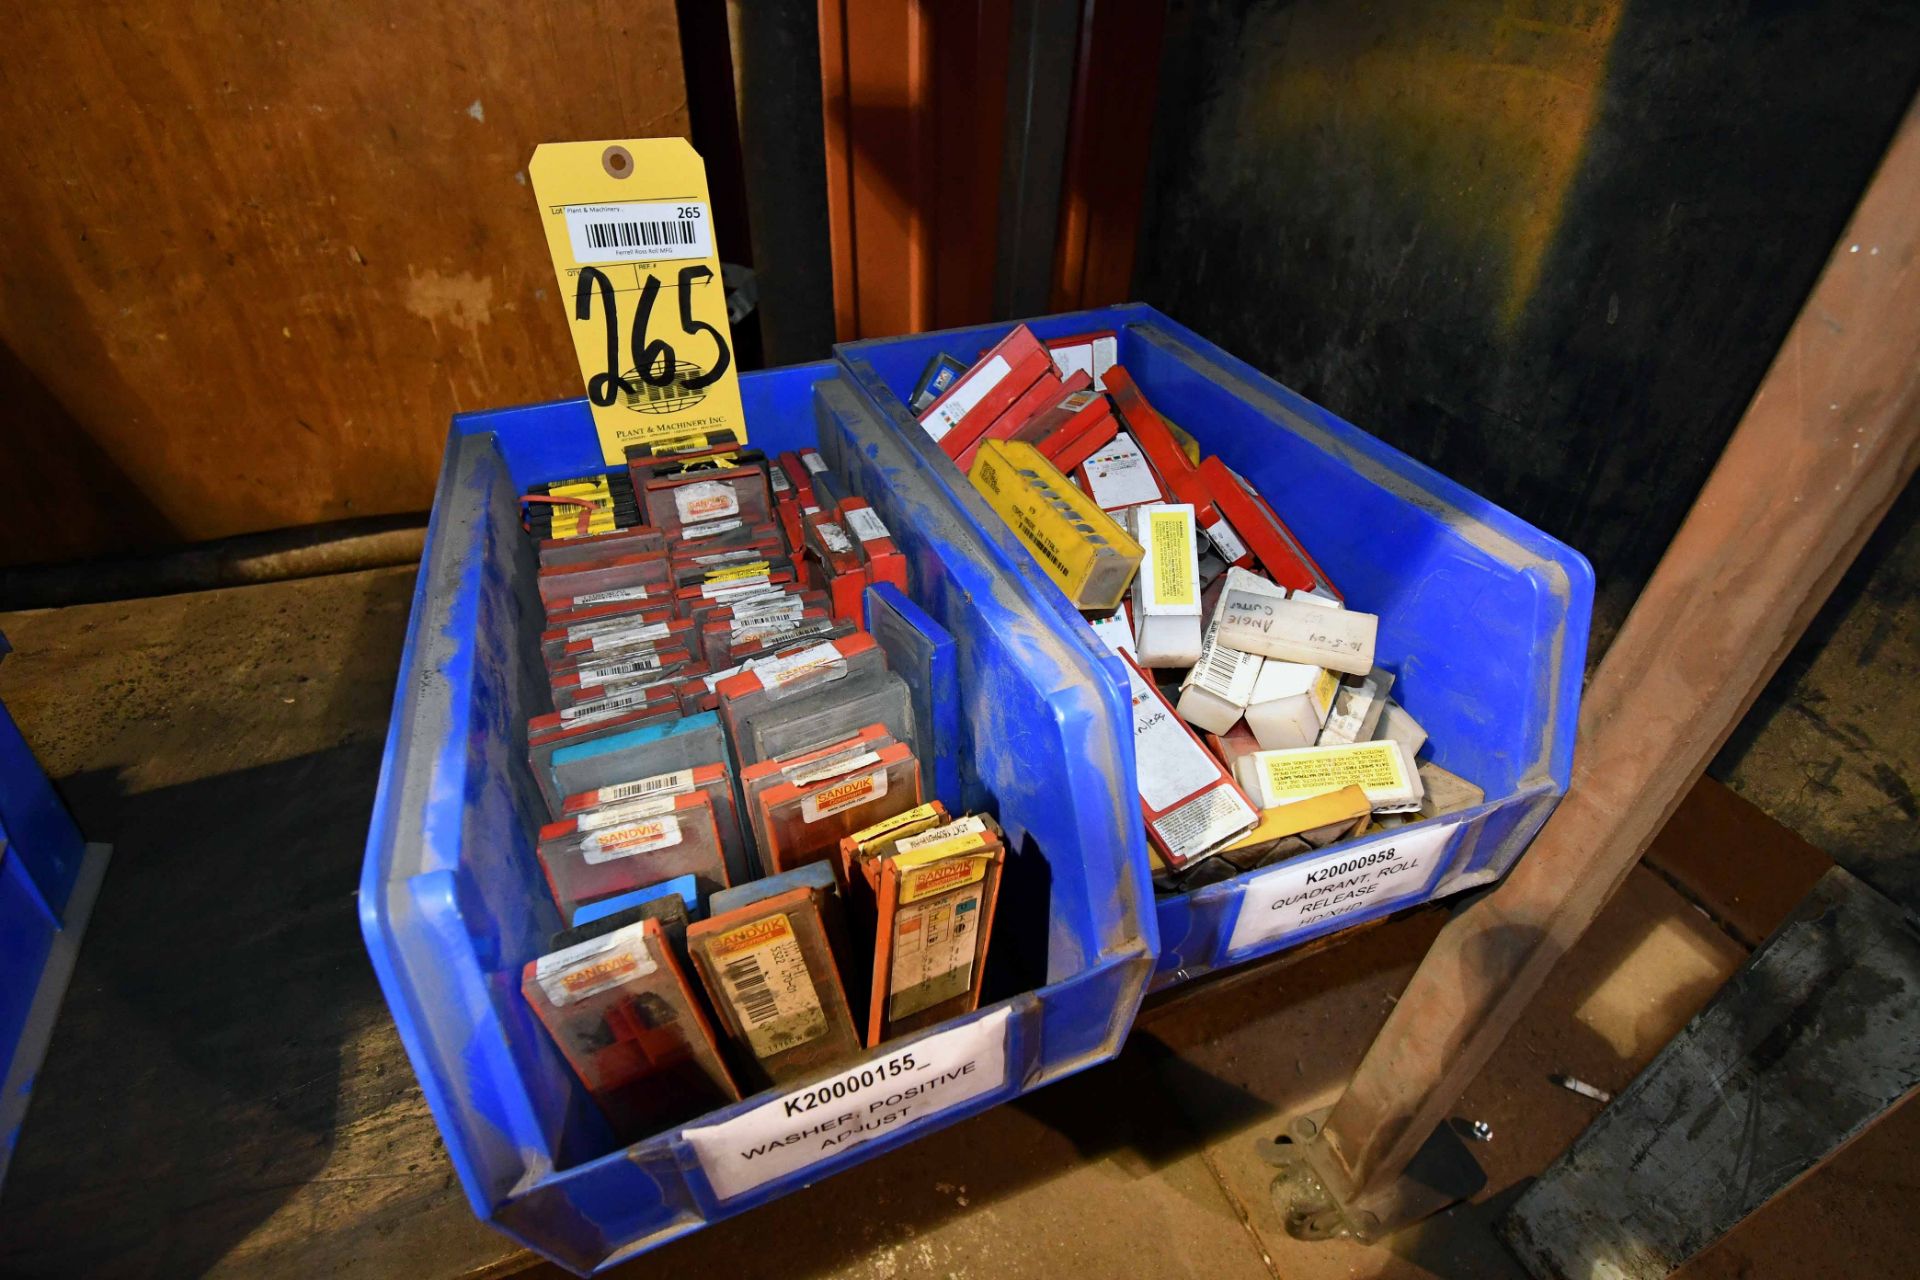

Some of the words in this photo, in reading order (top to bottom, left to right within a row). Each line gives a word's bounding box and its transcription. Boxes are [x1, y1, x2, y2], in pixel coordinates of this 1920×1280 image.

[590, 206, 620, 214] Machinery
[677, 206, 701, 219] 265
[576, 265, 731, 407] 265
[616, 428, 644, 439] PLANT
[656, 419, 707, 432] MACHINERY
[709, 415, 727, 425] INC.
[816, 776, 875, 803] SANDVIK
[597, 822, 662, 849] SANDVIK
[917, 860, 973, 883] SANDVIK
[1271, 873, 1371, 911] QUADRANT,
[1377, 858, 1419, 878] ROLL
[1300, 883, 1379, 914] RELEASE
[711, 918, 784, 951] SANDVIK
[564, 953, 633, 986] SANDVIK
[740, 1110, 863, 1161] WASHER,
[868, 1060, 977, 1115] POSITIVE
[820, 1106, 912, 1150] ADJUST
